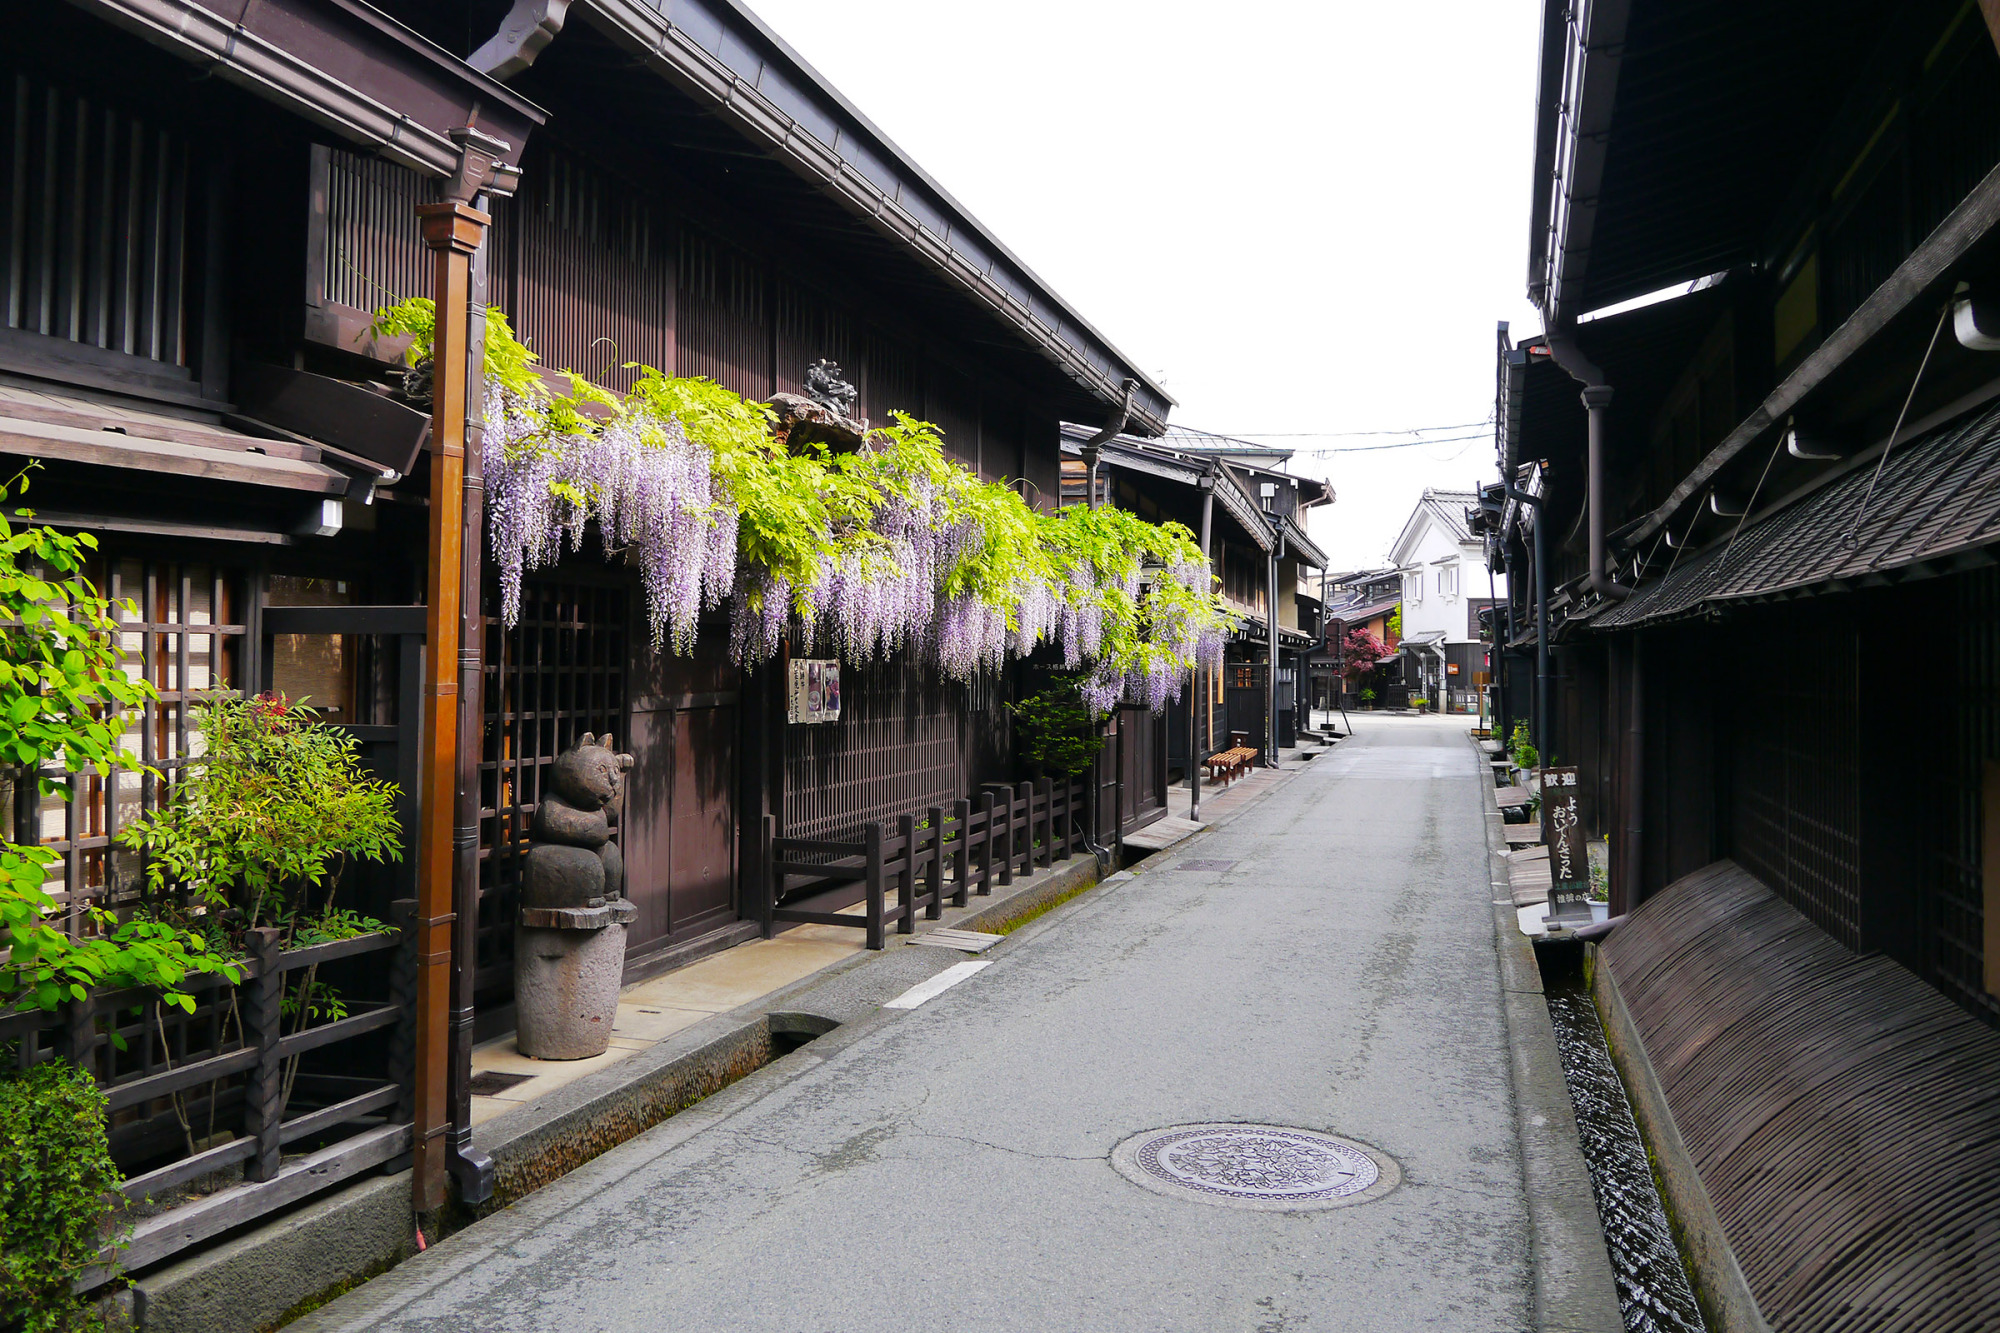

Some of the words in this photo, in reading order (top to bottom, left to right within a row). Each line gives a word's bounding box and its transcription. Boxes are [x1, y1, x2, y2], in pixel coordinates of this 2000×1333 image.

[1032, 663, 1066, 671] ホース格納
[1544, 772, 1577, 787] 歓迎
[1567, 796, 1578, 826] よう
